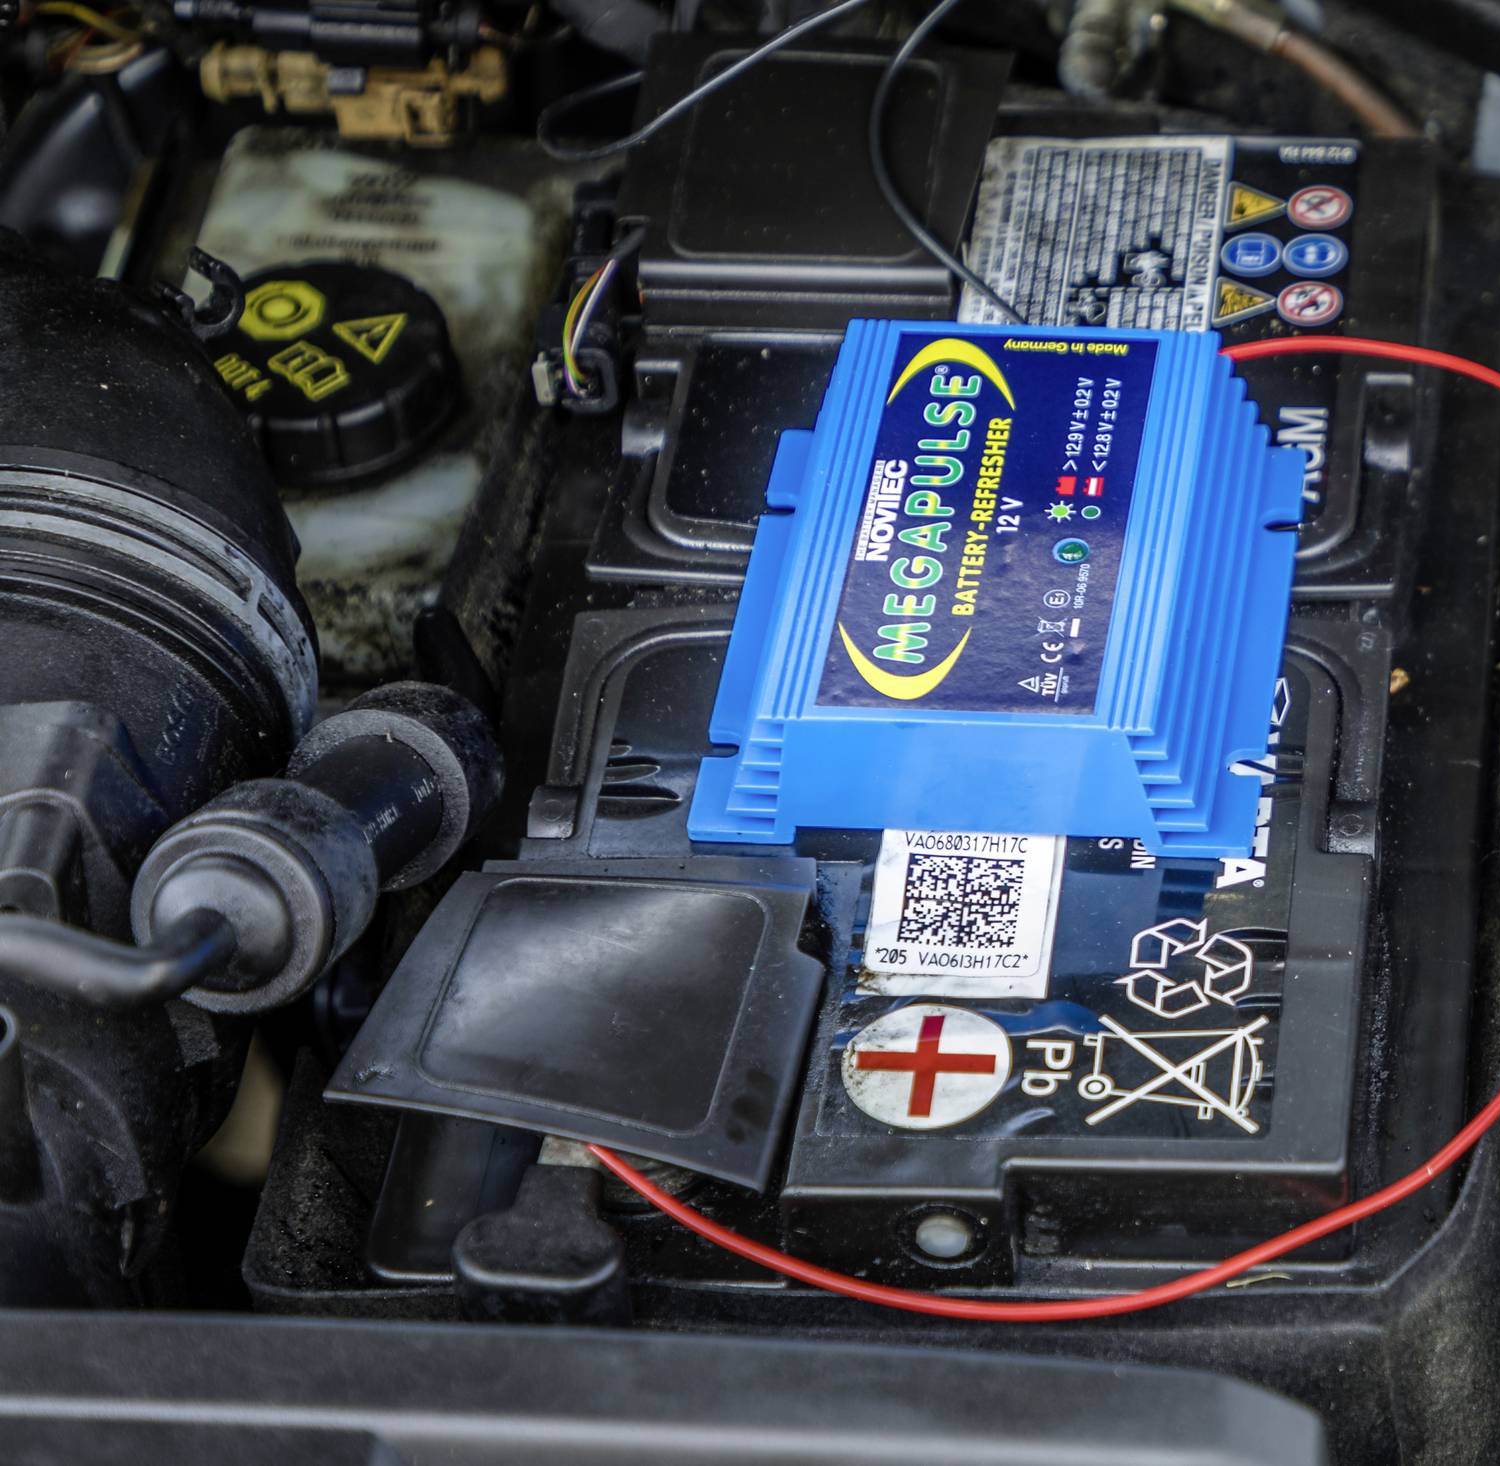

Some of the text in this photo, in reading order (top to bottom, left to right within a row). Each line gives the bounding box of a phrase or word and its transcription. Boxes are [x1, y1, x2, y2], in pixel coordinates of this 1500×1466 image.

[1003, 338, 1128, 356] Made in Germany
[1078, 376, 1095, 387] V
[1105, 378, 1123, 388] V
[1074, 388, 1094, 407] 0.2
[1102, 389, 1120, 408] 0.2
[1069, 421, 1086, 430] V
[1098, 421, 1114, 431] V
[1065, 432, 1085, 457] 12.9
[1093, 433, 1112, 458] 12.8
[866, 459, 909, 561] NOVITEC
[951, 417, 1013, 616] BATTERY-REFRESHER
[995, 496, 1023, 533] 12 V
[1040, 672, 1058, 697] TÜV
[1021, 1039, 1075, 1097] Pb
